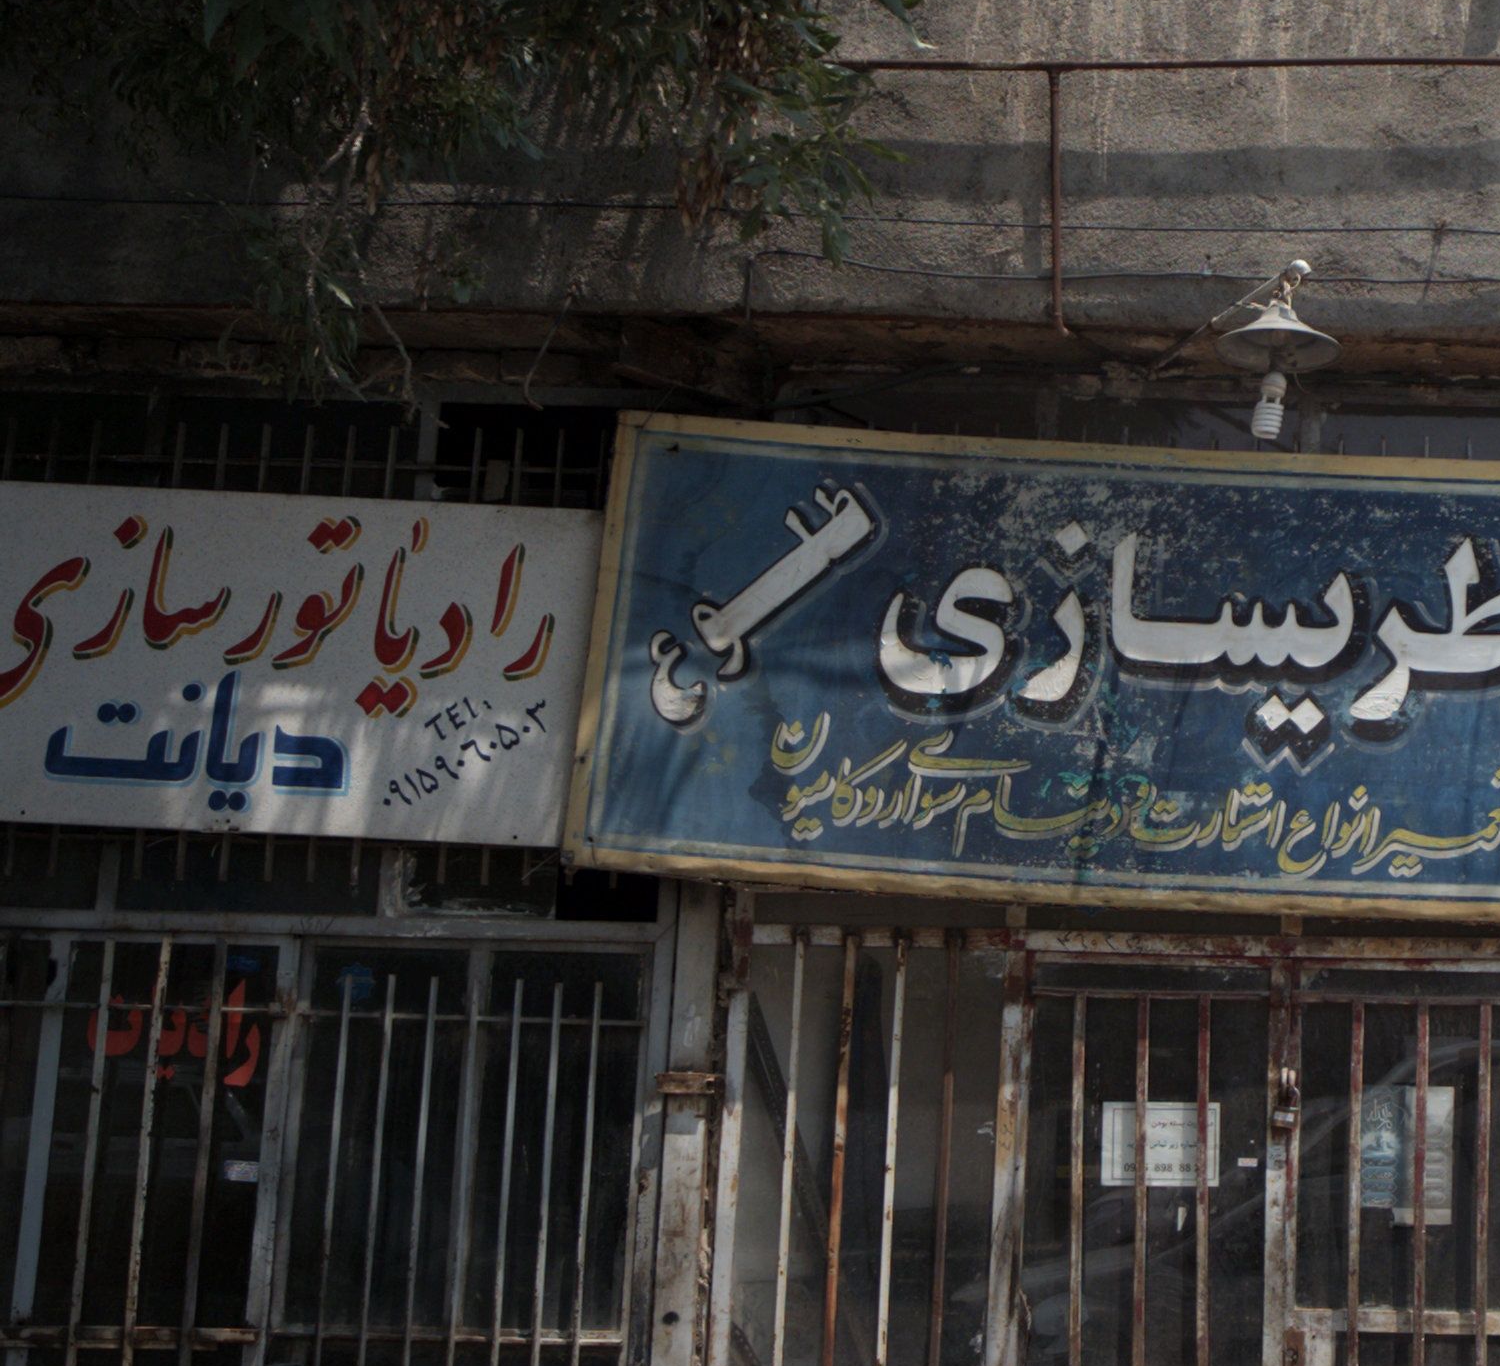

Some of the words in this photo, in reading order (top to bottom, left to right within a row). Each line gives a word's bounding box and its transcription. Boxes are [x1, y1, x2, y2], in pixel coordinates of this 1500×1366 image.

[44, 670, 349, 812] دیانت
[770, 711, 908, 841] کامیون
[951, 773, 1131, 859] دینام
[1131, 782, 1287, 852] استارت
[1277, 785, 1382, 878] انواع
